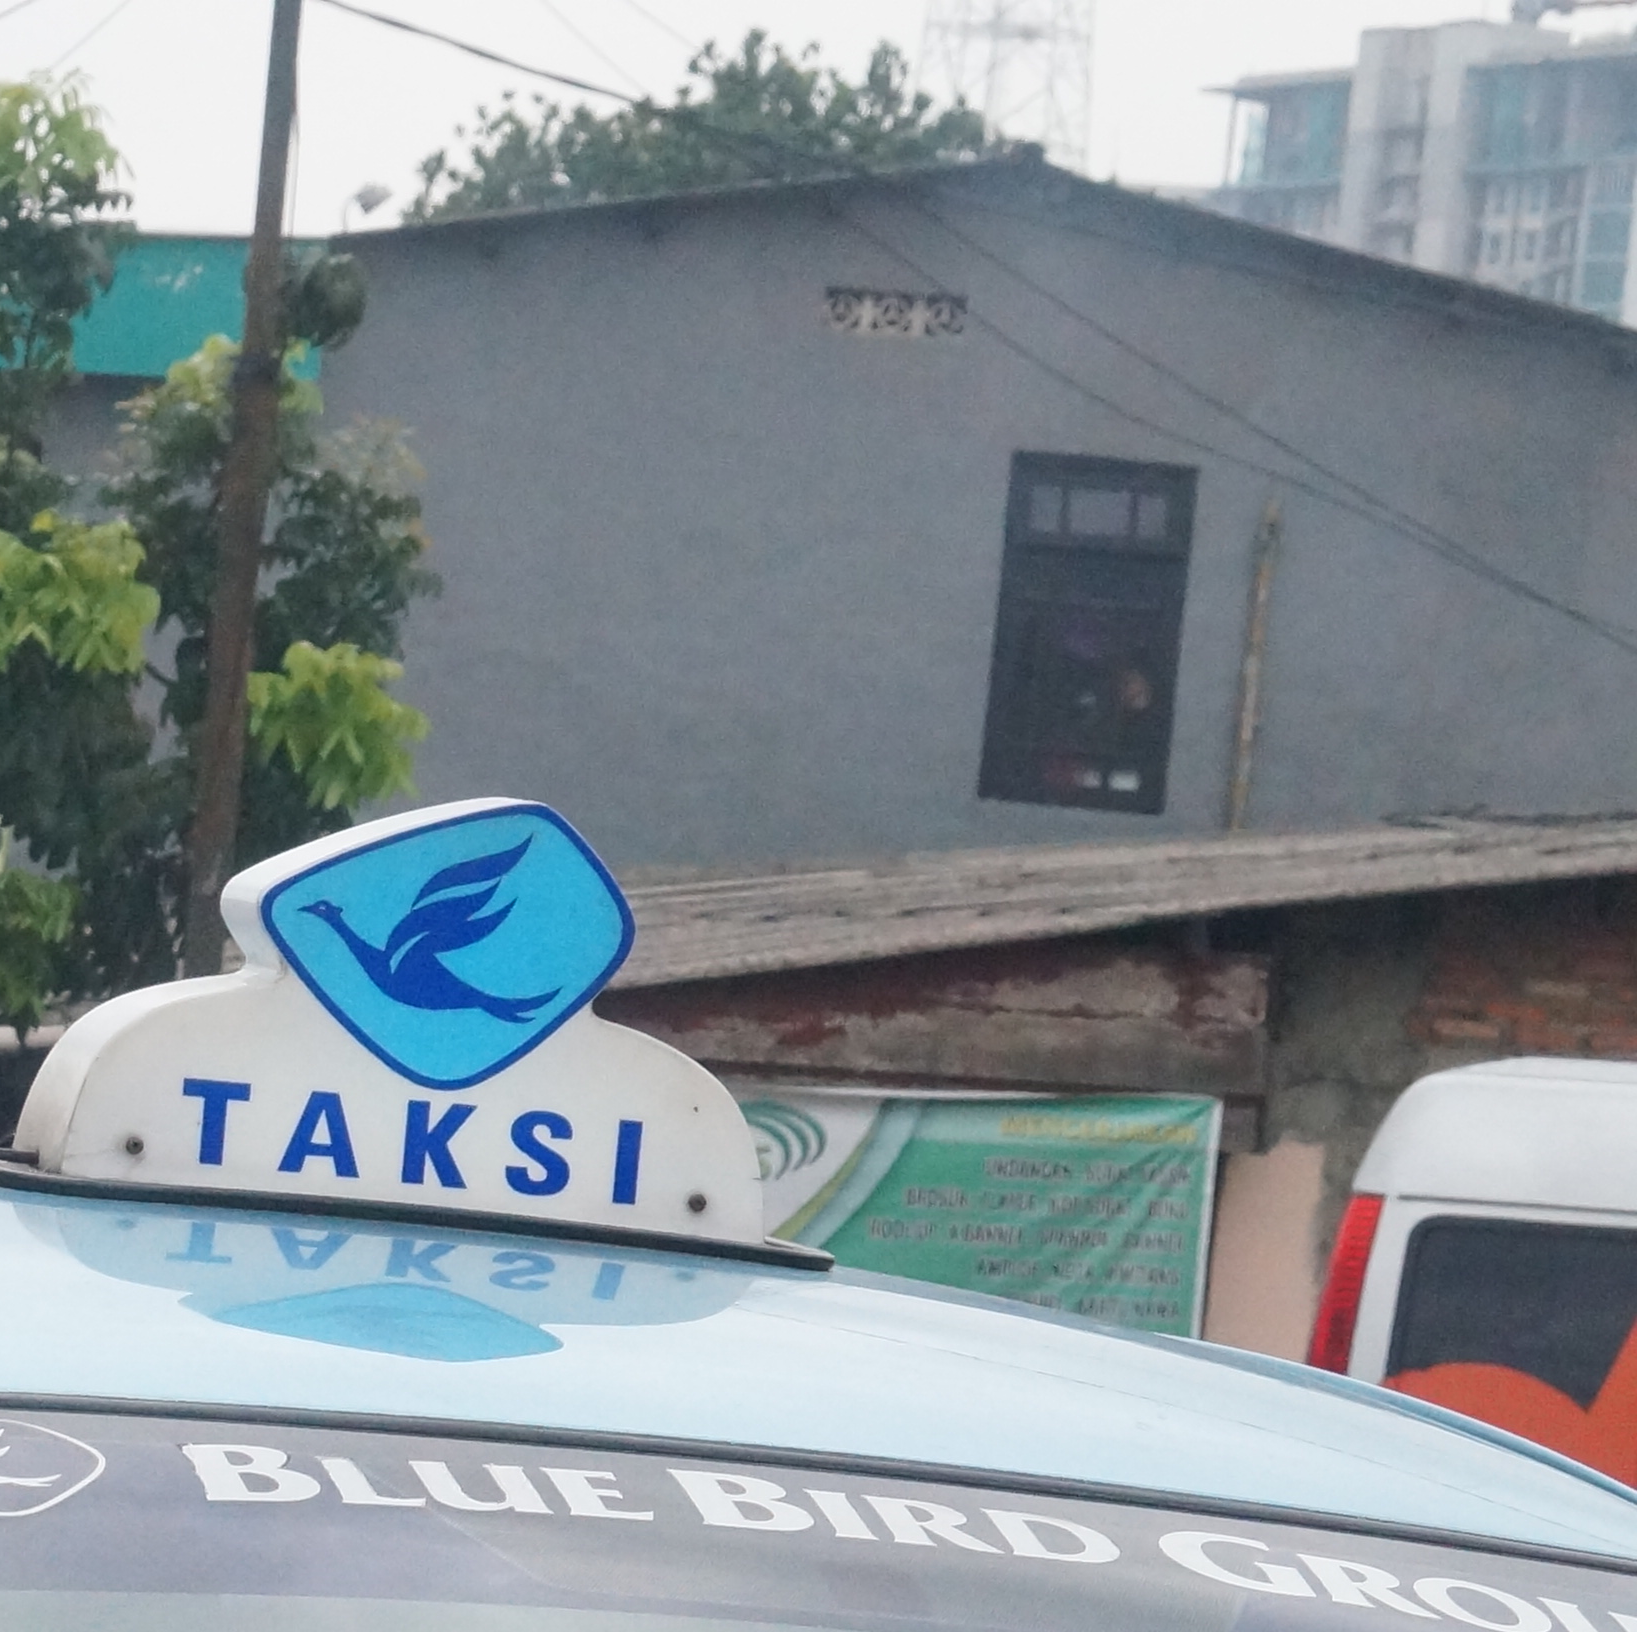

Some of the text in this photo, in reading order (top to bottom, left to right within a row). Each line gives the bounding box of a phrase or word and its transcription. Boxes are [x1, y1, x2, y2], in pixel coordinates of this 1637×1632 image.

[182, 1077, 643, 1205] TAKSI
[181, 1443, 654, 1521] BLUE
[667, 1468, 1122, 1564] BIRD
